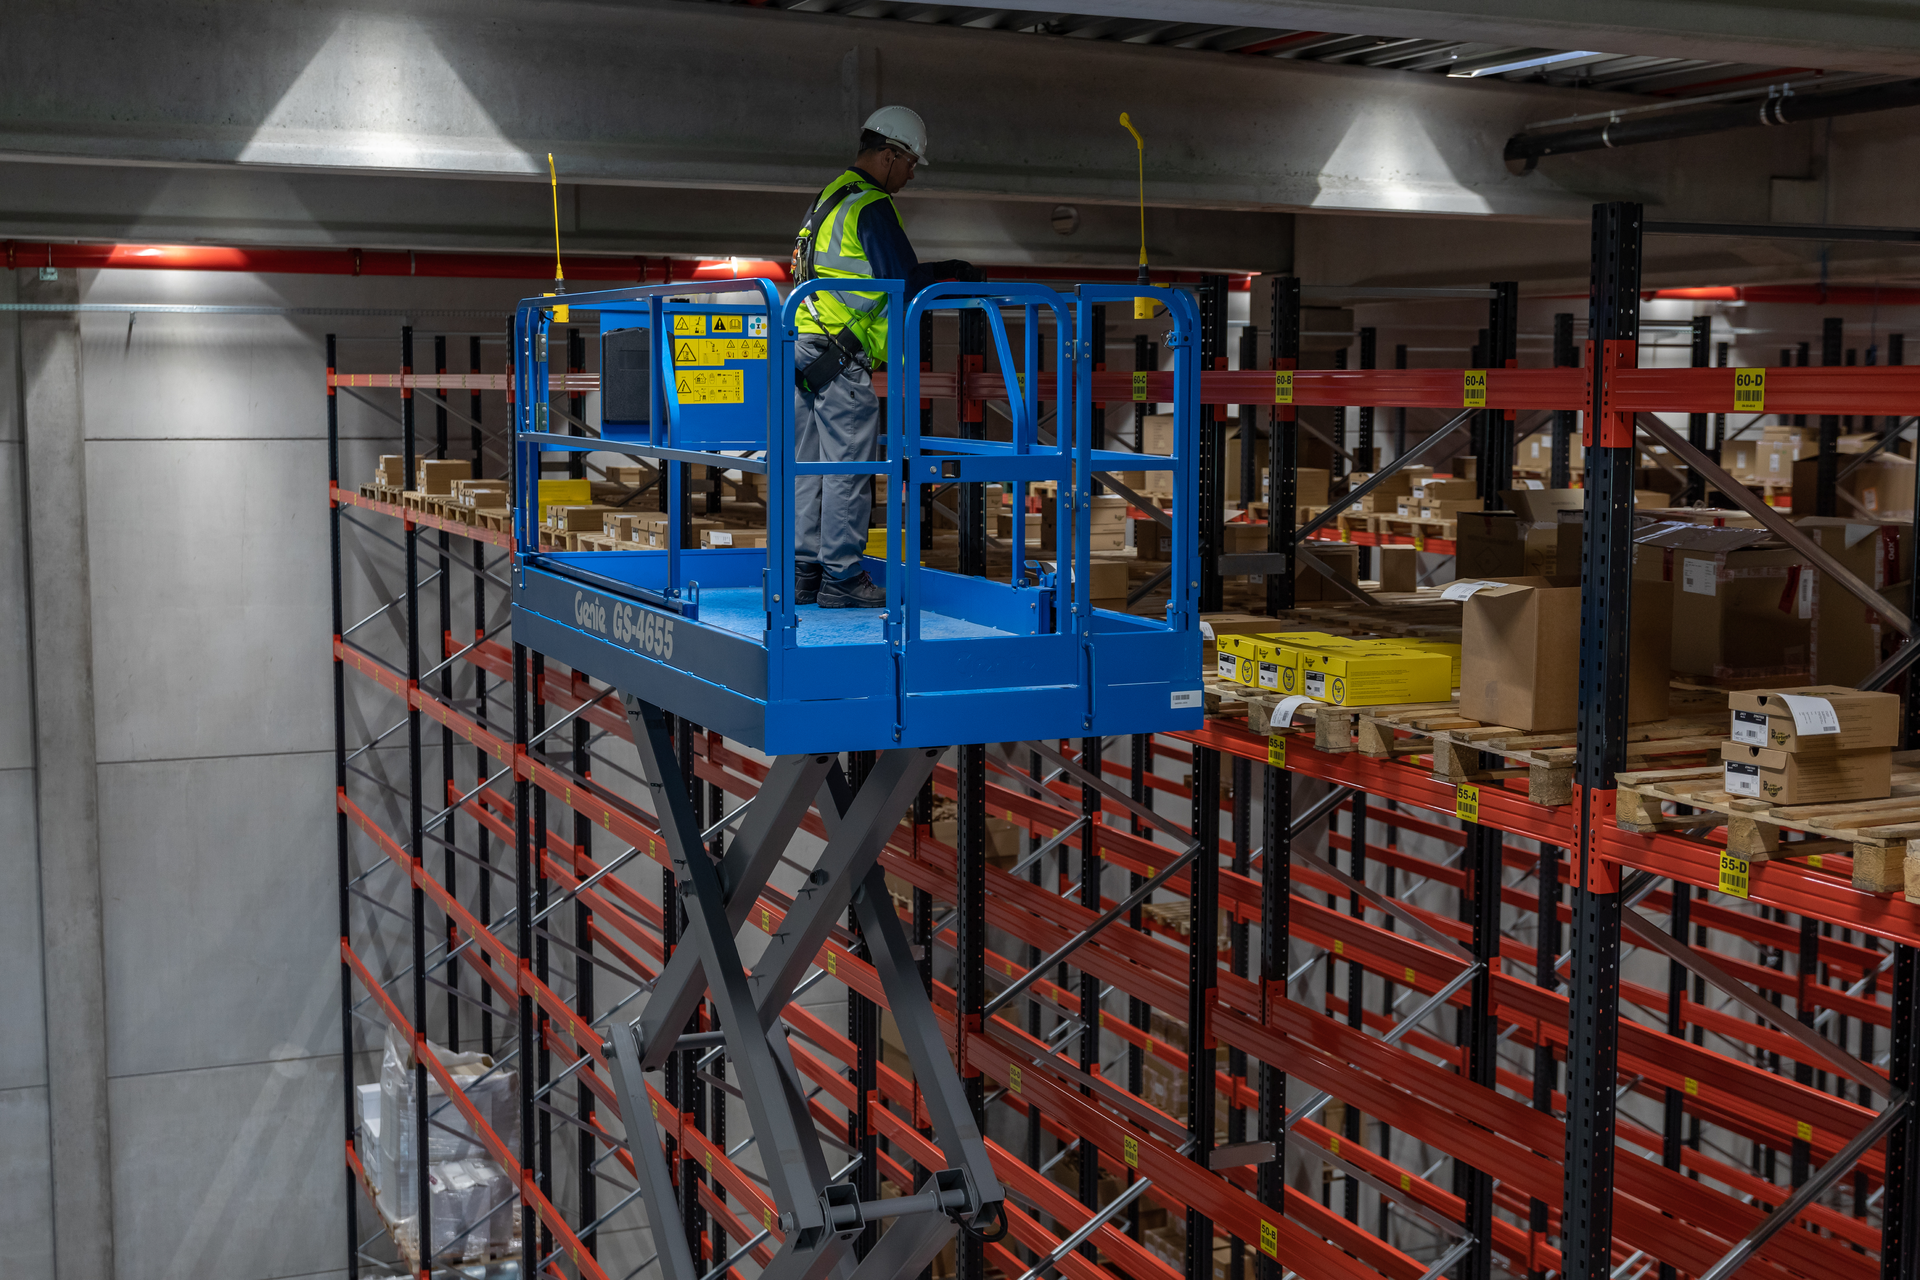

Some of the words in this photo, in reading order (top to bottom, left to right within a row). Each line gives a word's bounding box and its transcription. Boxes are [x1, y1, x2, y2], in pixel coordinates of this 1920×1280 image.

[1133, 375, 1146, 384] 60-C
[1276, 375, 1292, 385] 60-B
[1465, 375, 1485, 386] 60-A
[1737, 374, 1763, 386] 60-D
[1887, 541, 1895, 561] XPO
[574, 590, 606, 634] Genie
[612, 601, 674, 660] GS-4655
[1269, 738, 1285, 750] 55-B
[1458, 788, 1477, 802] 55-A
[1721, 857, 1747, 873] 55-D
[1125, 1138, 1137, 1153] 50-C
[1261, 1223, 1276, 1240] 50-B
